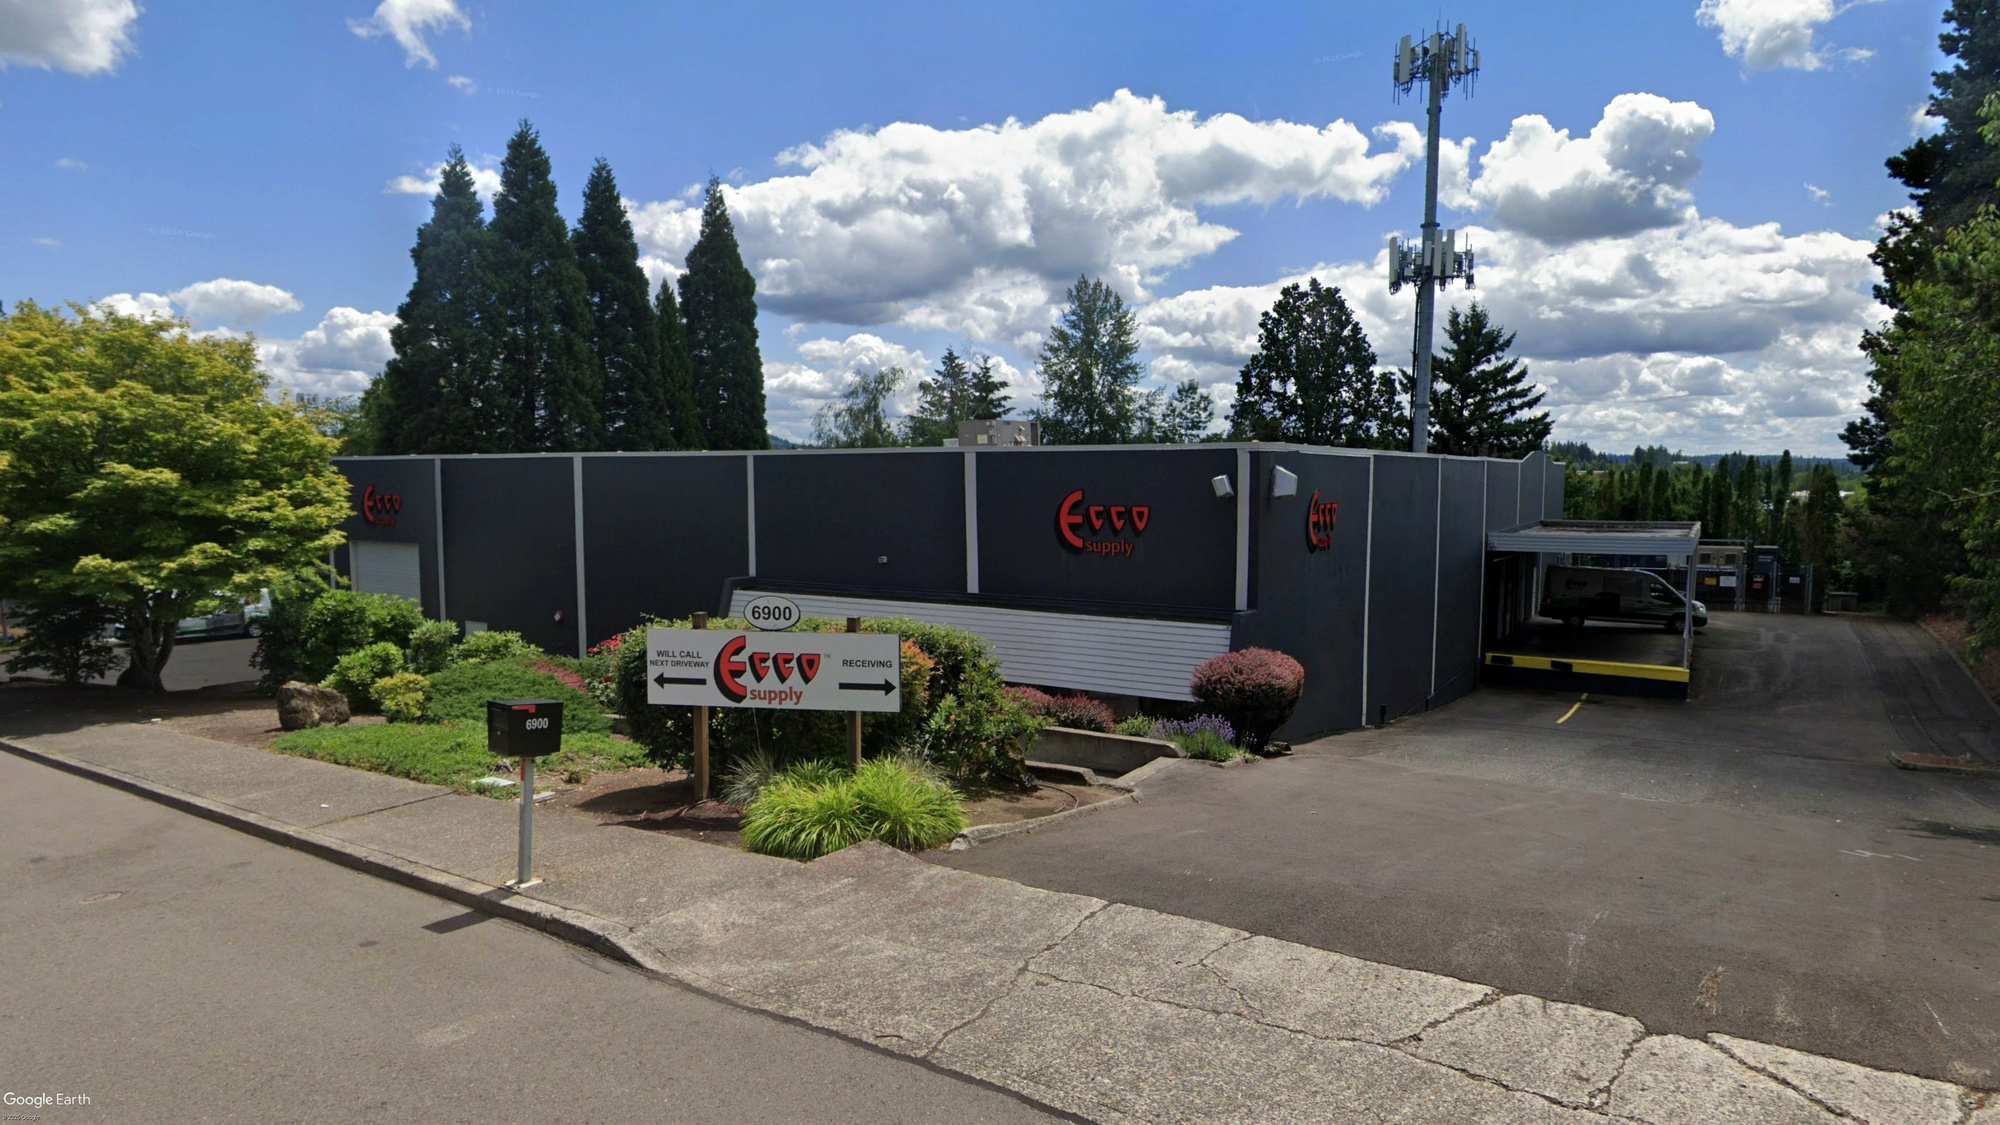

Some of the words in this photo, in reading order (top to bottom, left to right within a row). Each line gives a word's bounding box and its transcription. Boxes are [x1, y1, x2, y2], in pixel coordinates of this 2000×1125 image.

[1086, 540, 1133, 557] supply
[751, 605, 792, 621] 6900
[656, 649, 677, 658] WILL
[679, 650, 703, 659] CALL
[649, 659, 669, 667] NEXT
[670, 660, 710, 668] DRIVEWAY
[841, 659, 893, 668] RECEIVING
[749, 687, 803, 705] supply
[525, 717, 549, 731] 6900
